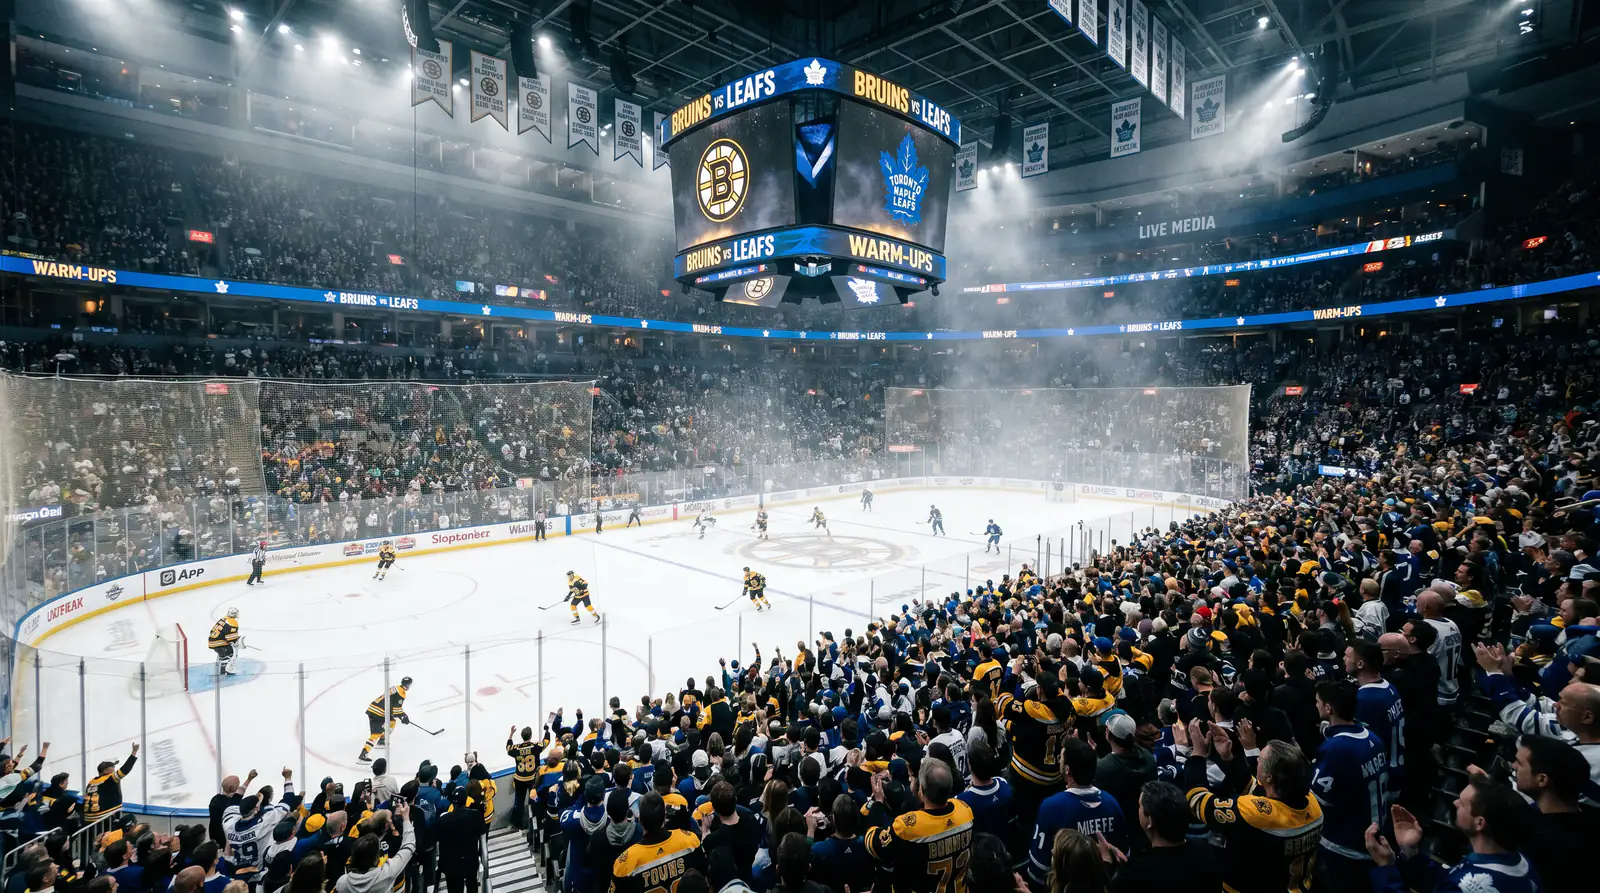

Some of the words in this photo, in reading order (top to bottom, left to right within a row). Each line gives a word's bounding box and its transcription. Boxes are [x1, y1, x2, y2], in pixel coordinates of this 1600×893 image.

[672, 94, 711, 136] BRUINS
[726, 70, 776, 108] LEAFS
[854, 70, 909, 114] BRUINS
[922, 99, 950, 136] LEAFS
[889, 174, 922, 195] TORONTO
[894, 186, 916, 202] MAPLE
[893, 196, 916, 211] LEAFS
[1140, 222, 1167, 239] LIVE
[1172, 216, 1216, 234] MEDIA
[686, 246, 722, 272] BRUINS
[734, 235, 774, 262] LEAFS
[848, 234, 933, 272] WARM-UPS
[32, 260, 116, 283] WARM-UPS
[340, 292, 376, 306] BRUINS
[389, 296, 418, 310] LEAFS
[554, 312, 592, 324] WARM-UPS
[1313, 306, 1362, 320] WARM-UPS
[982, 330, 1017, 339] WARM-UPS
[1126, 322, 1152, 332] BRUINS
[1160, 320, 1182, 330] LEAFS
[838, 332, 860, 340] BRUINS
[867, 332, 886, 340] LEAFS
[516, 754, 536, 772] 38
